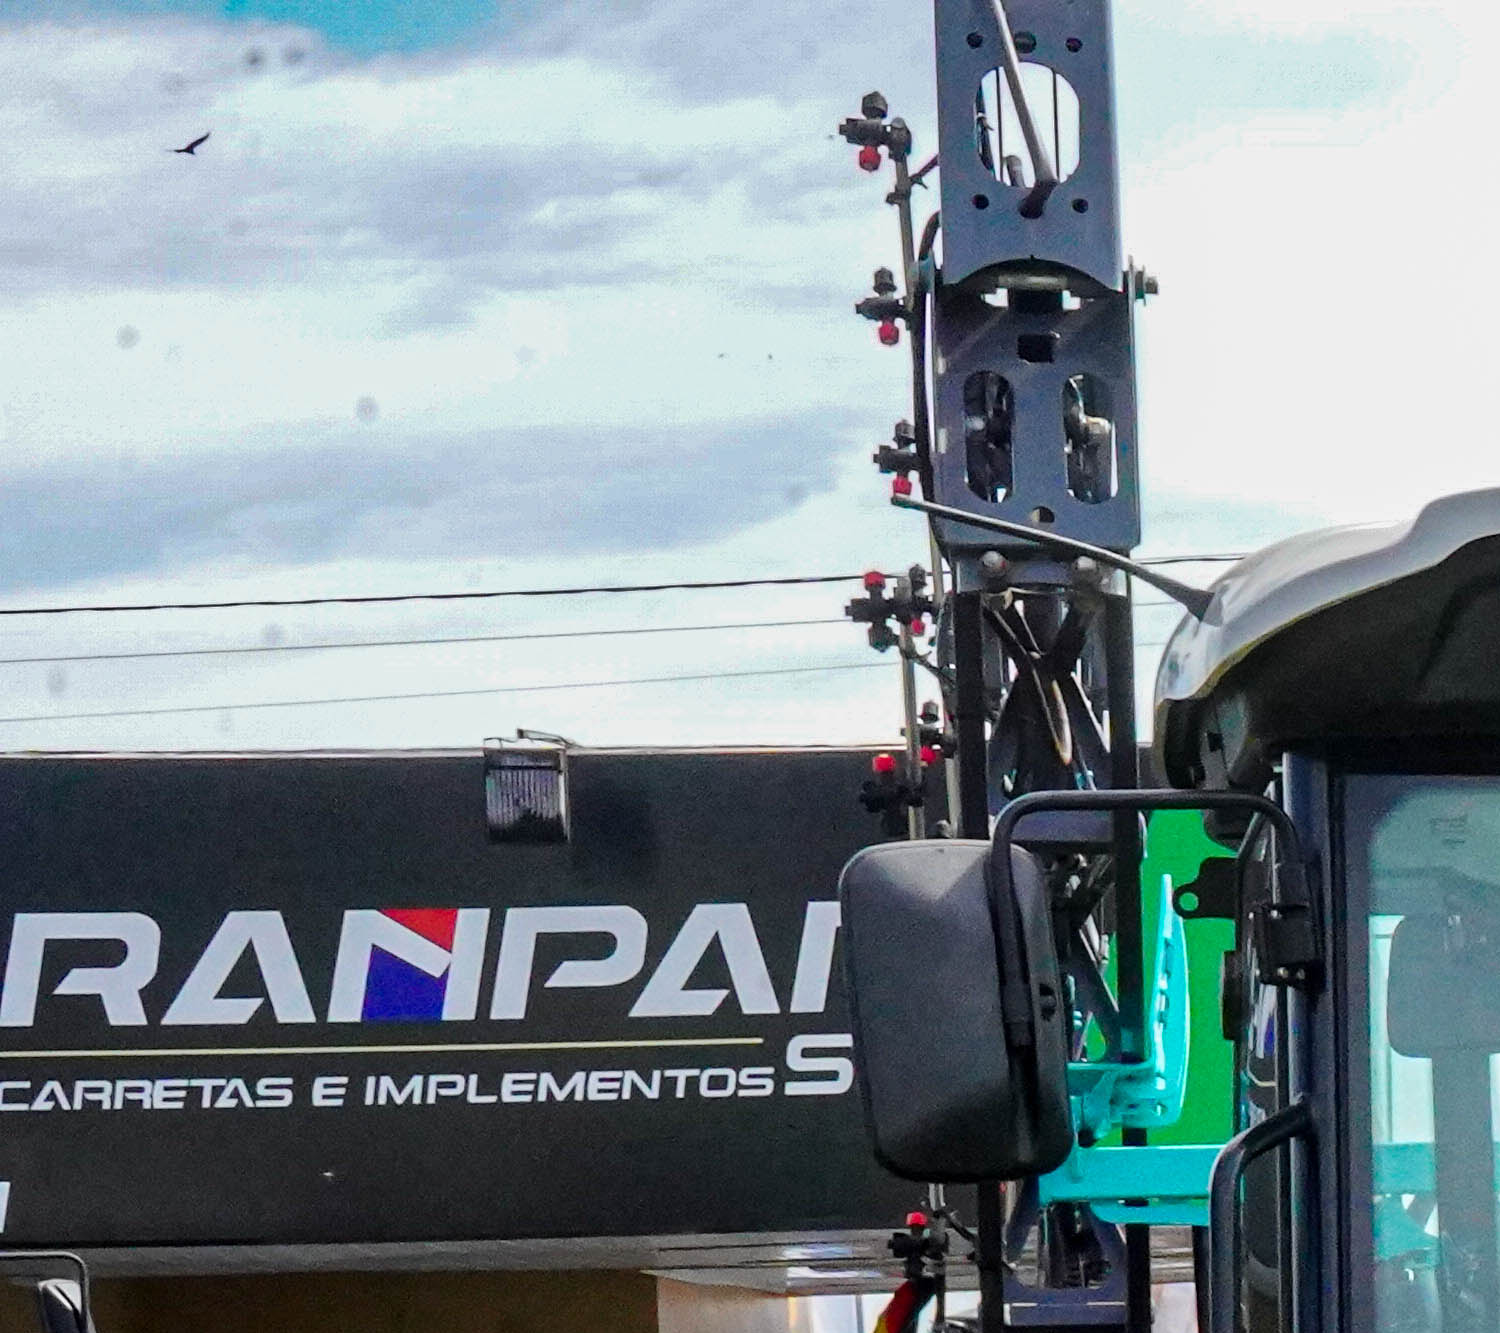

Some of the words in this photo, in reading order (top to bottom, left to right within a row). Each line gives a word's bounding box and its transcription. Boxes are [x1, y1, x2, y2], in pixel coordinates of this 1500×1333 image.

[0, 1075, 293, 1112] CARRETAS
[311, 1075, 347, 1108] E
[365, 1066, 776, 1106] IMPLEMENTOS
